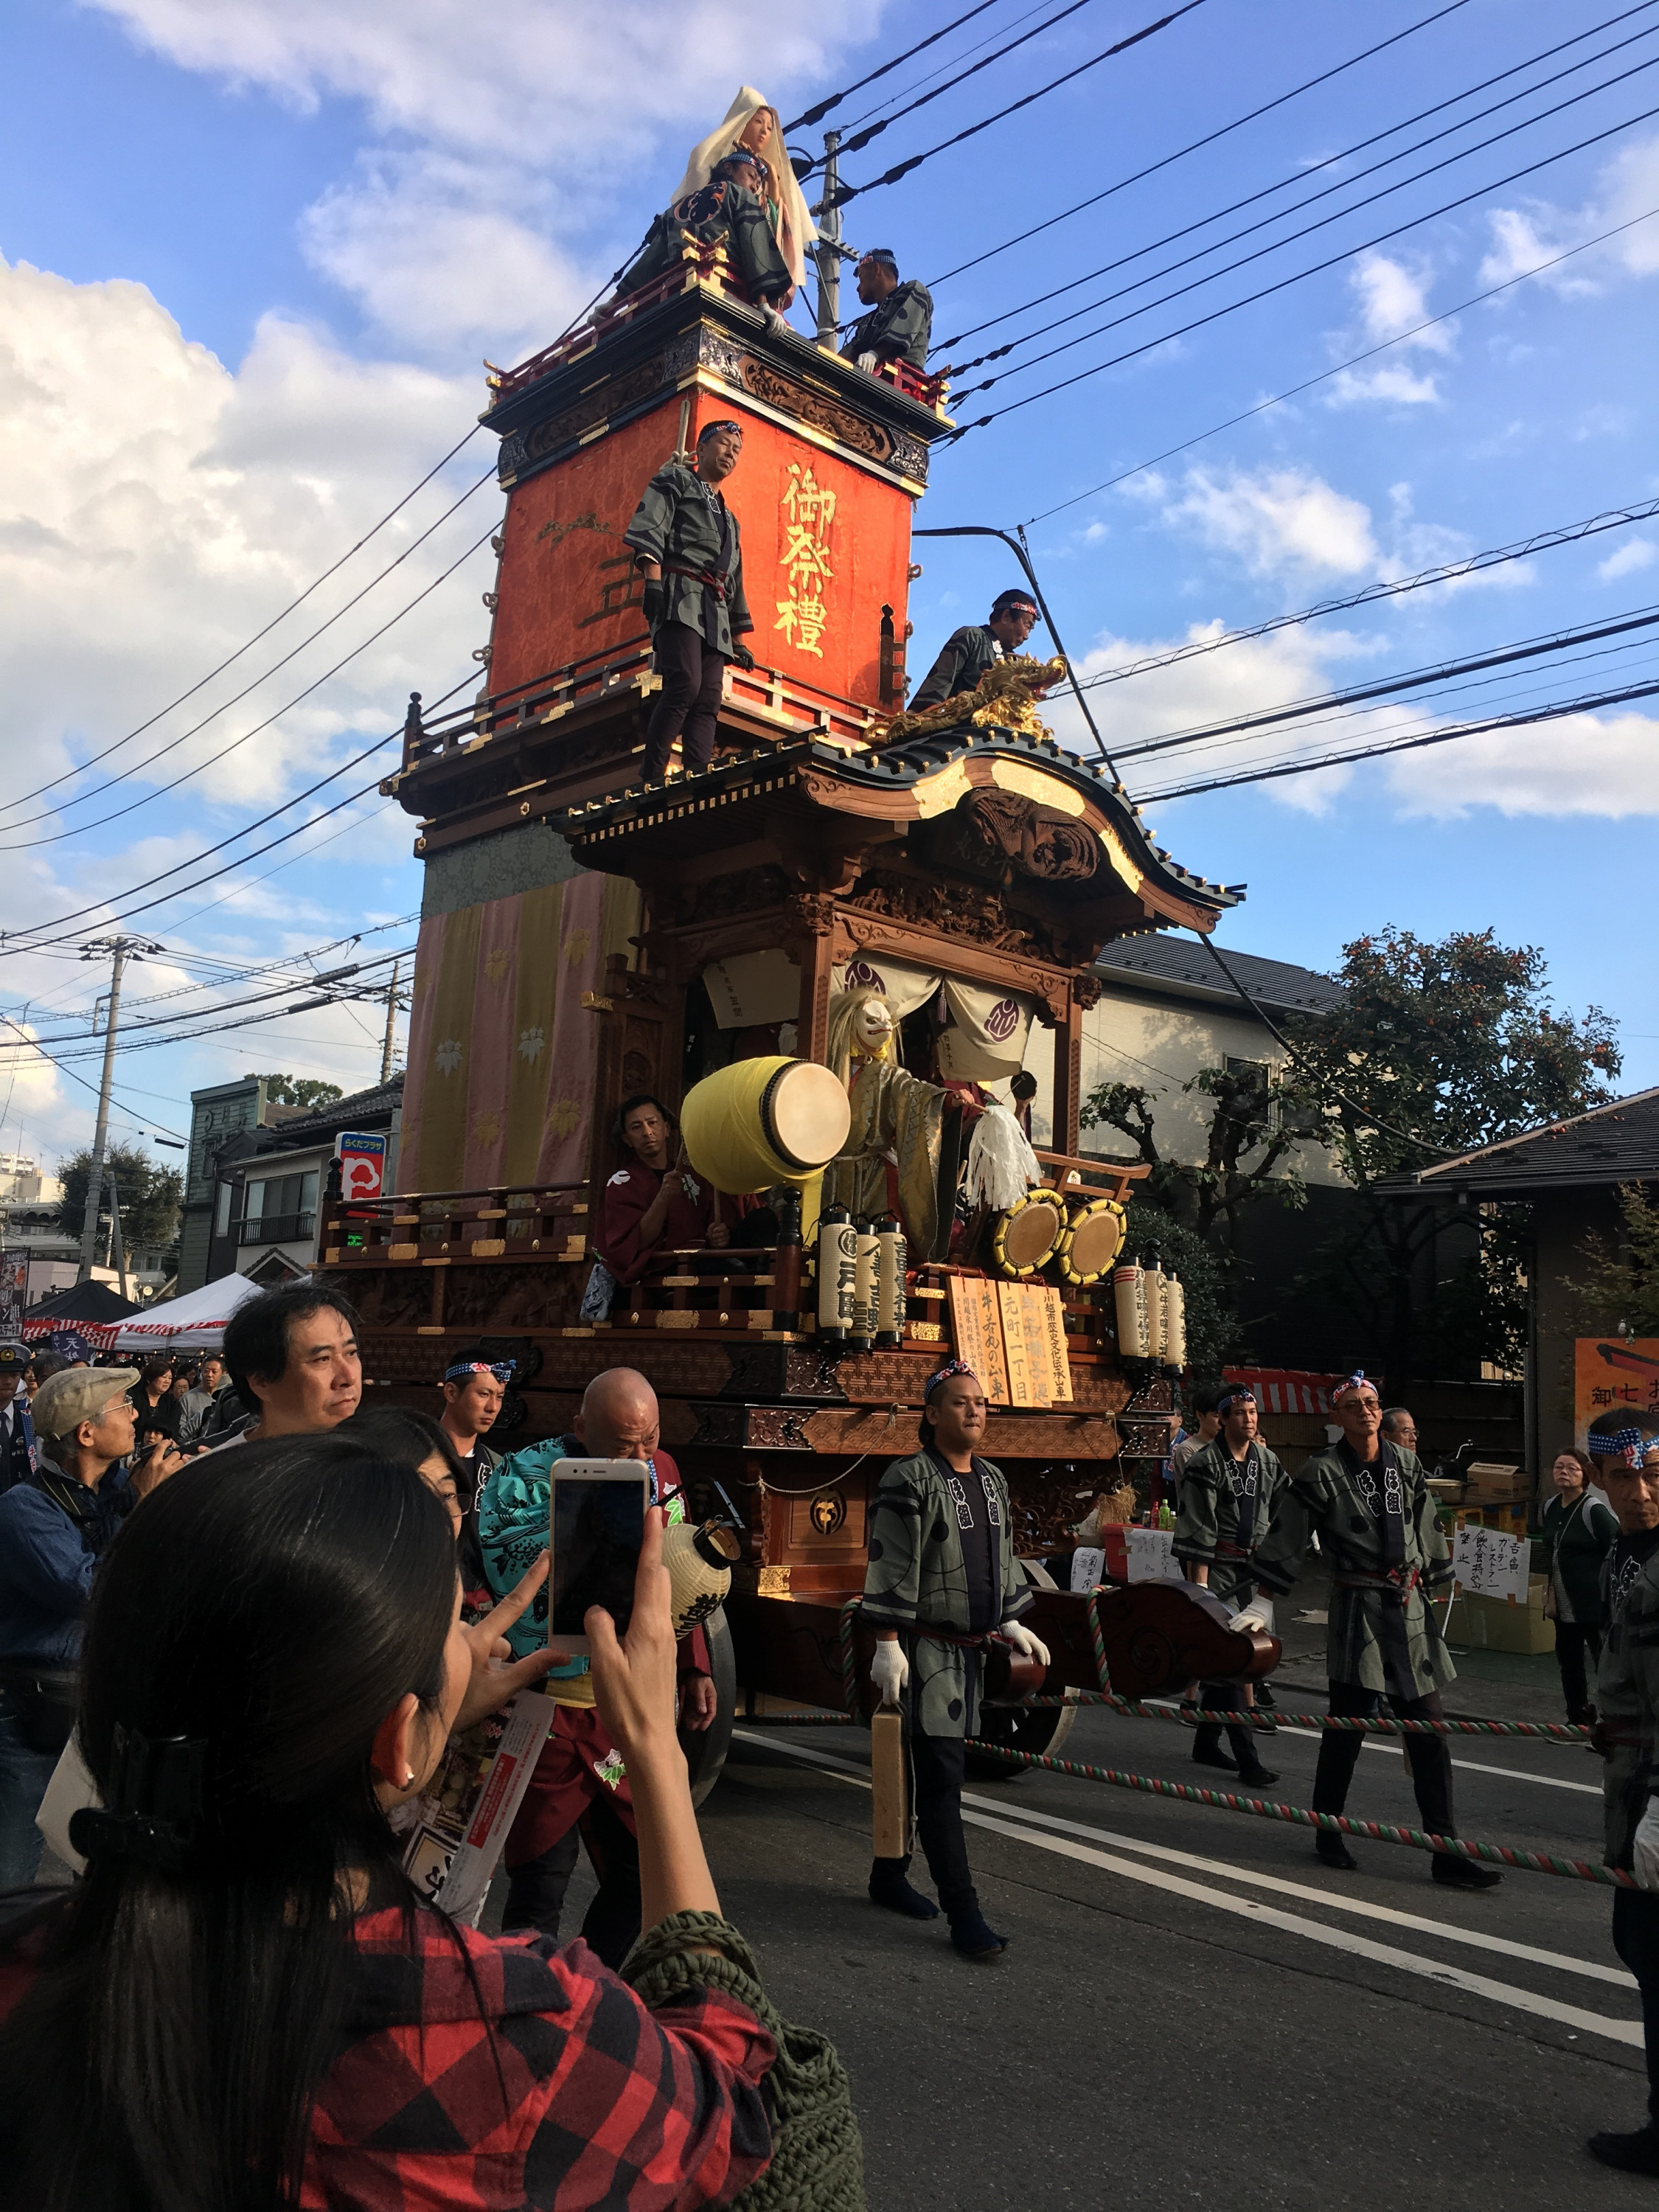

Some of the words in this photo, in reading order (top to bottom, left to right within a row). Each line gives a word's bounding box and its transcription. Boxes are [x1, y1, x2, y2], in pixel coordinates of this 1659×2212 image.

[773, 463, 836, 658] 御祭禮
[345, 1138, 382, 1151] らくだプラザ
[981, 1291, 1005, 1400] 牛若丸の山車
[1004, 1296, 1027, 1402] 元町一丁目
[1043, 1295, 1066, 1397] 川越市歴史文化伝承山車
[1457, 1533, 1470, 1564] 禁止
